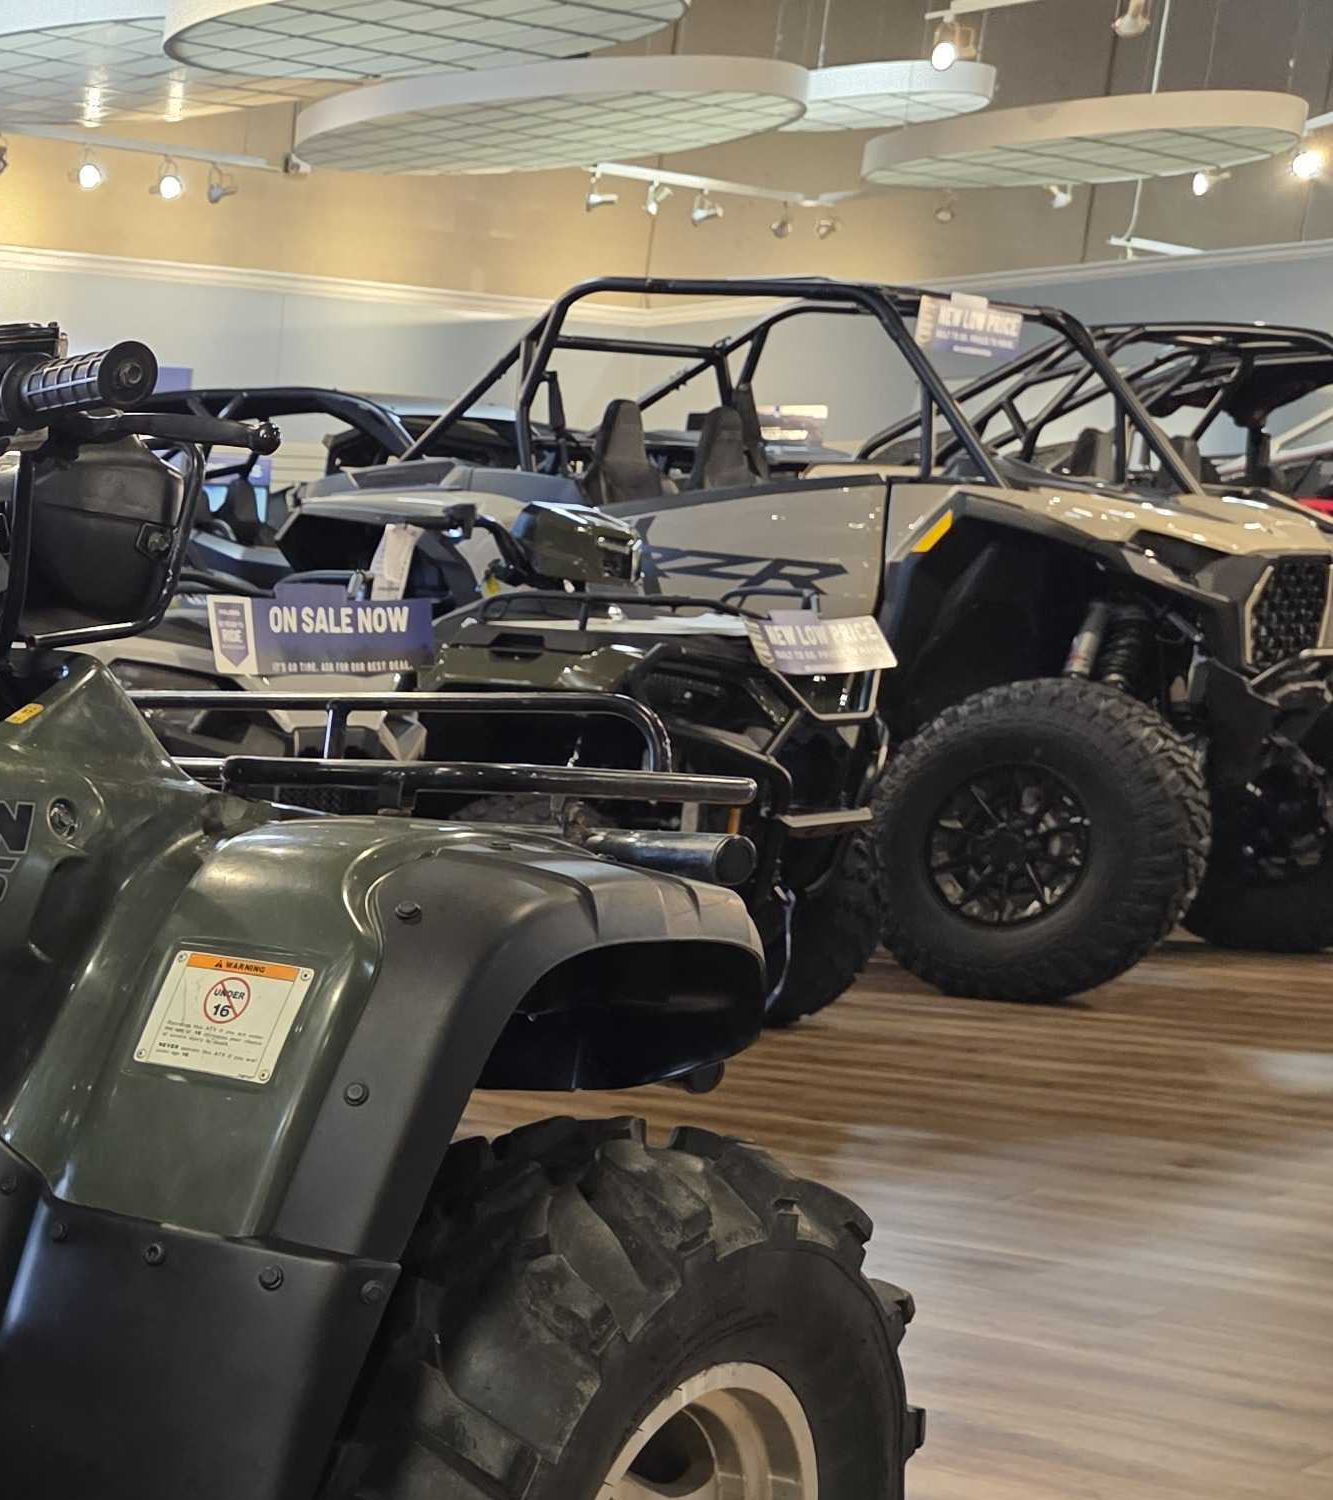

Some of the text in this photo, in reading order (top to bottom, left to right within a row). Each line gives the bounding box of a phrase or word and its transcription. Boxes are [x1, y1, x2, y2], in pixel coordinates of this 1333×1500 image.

[269, 606, 410, 634] ON SALE NOW
[764, 624, 797, 646] NEW
[795, 624, 830, 646] LOW
[827, 622, 879, 643] PRICE
[226, 960, 266, 973] WARNING
[213, 988, 245, 1000] UNDER
[213, 1003, 231, 1017] 16
